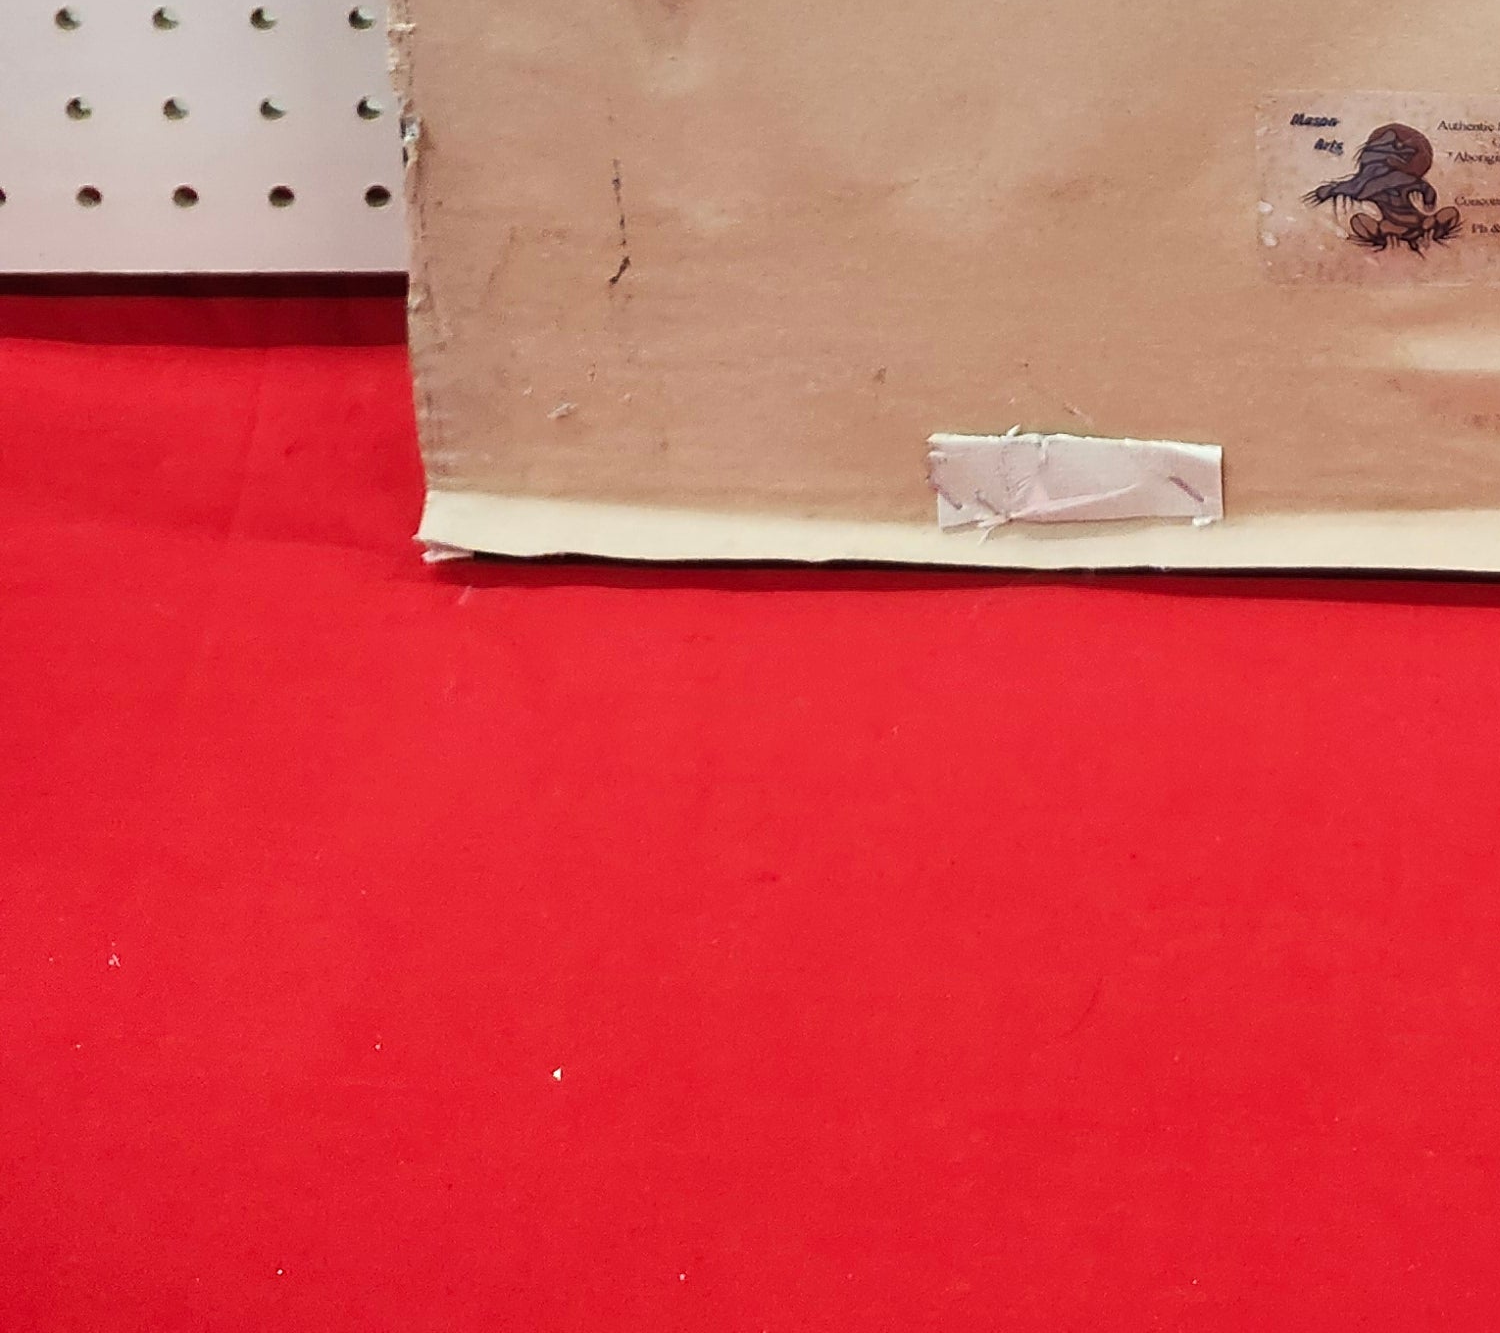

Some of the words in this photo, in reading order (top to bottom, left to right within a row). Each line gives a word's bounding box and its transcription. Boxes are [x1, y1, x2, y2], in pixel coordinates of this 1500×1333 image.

[1290, 113, 1340, 127] Mason
[1437, 120, 1494, 132] Authentic
[1314, 138, 1344, 155] Arts
